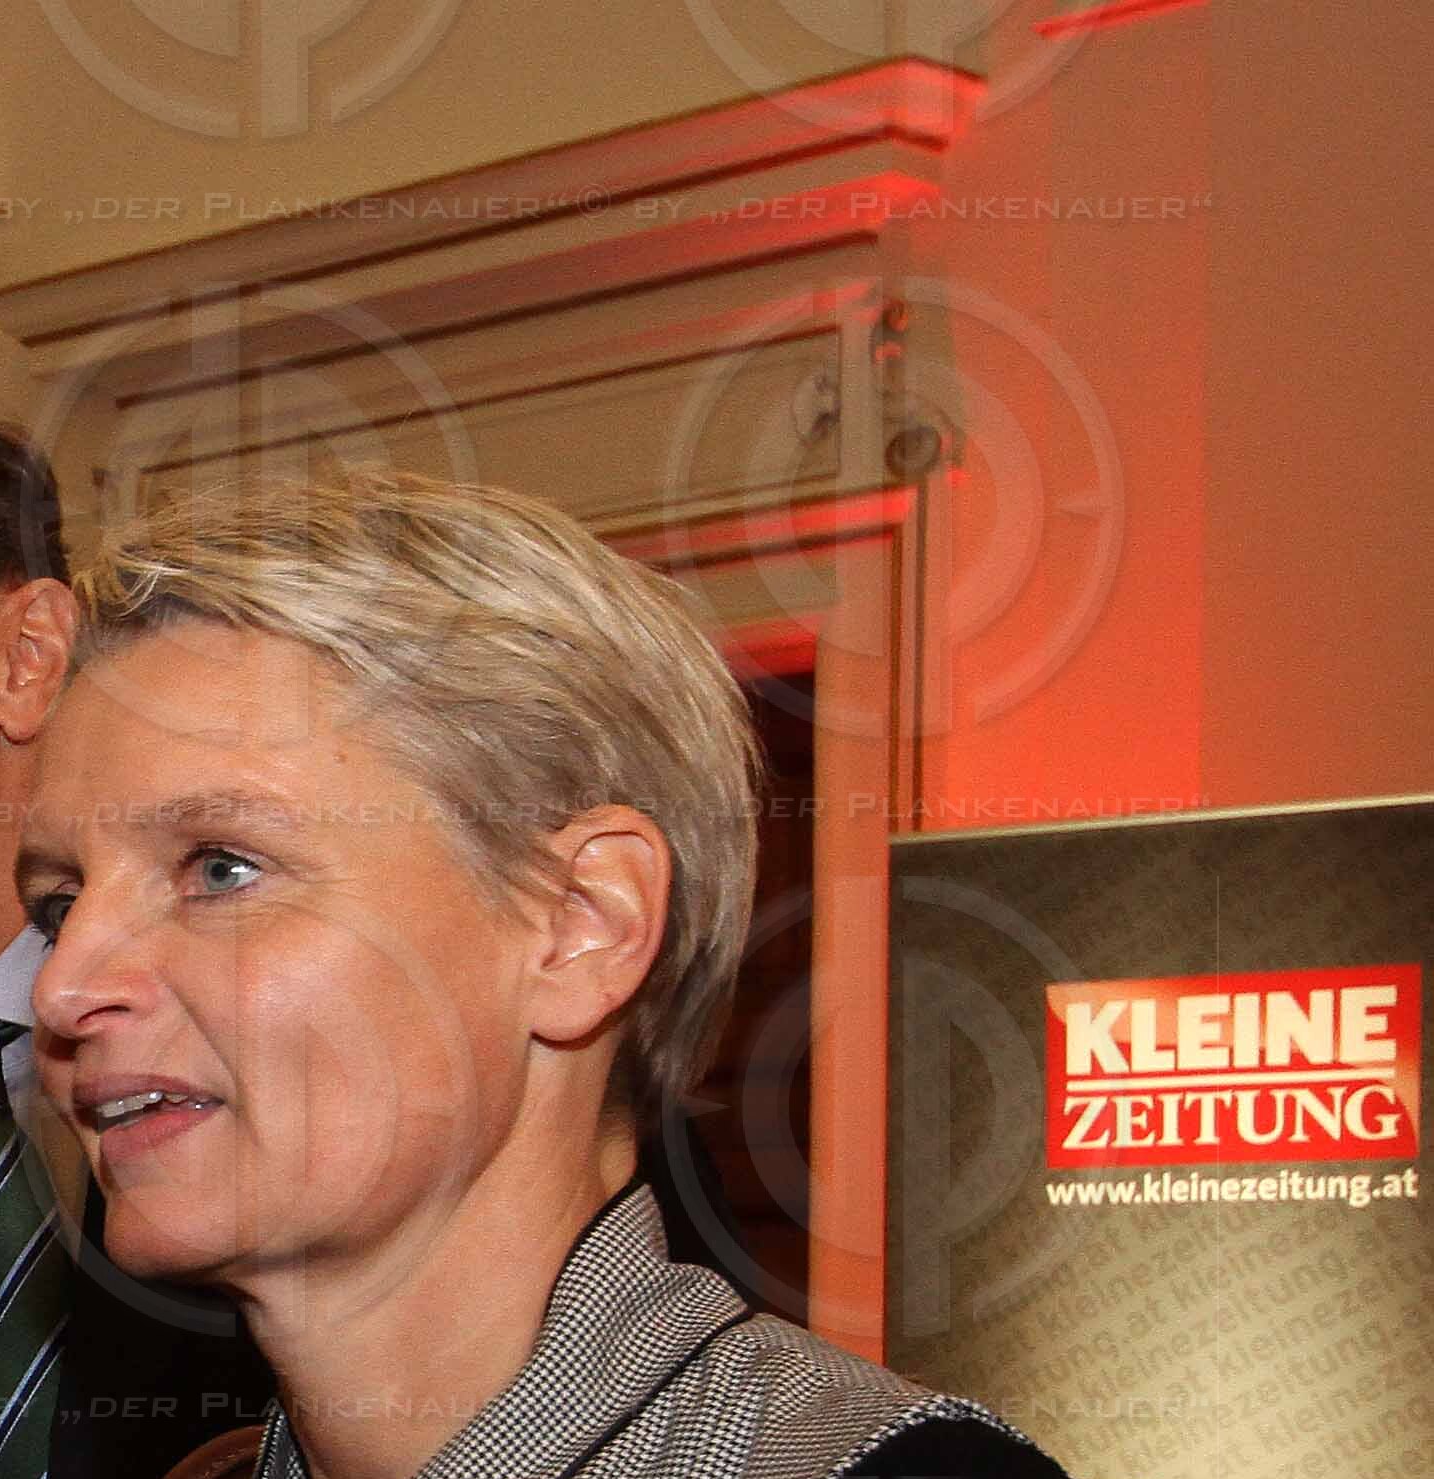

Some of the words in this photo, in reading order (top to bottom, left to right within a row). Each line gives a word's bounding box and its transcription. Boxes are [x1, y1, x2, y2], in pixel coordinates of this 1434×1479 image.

[1066, 985, 1397, 1076] KLEINE
[1062, 1085, 1402, 1150] ZEITUNG
[1046, 1167, 1419, 1208] www.kleinezeitung.at
